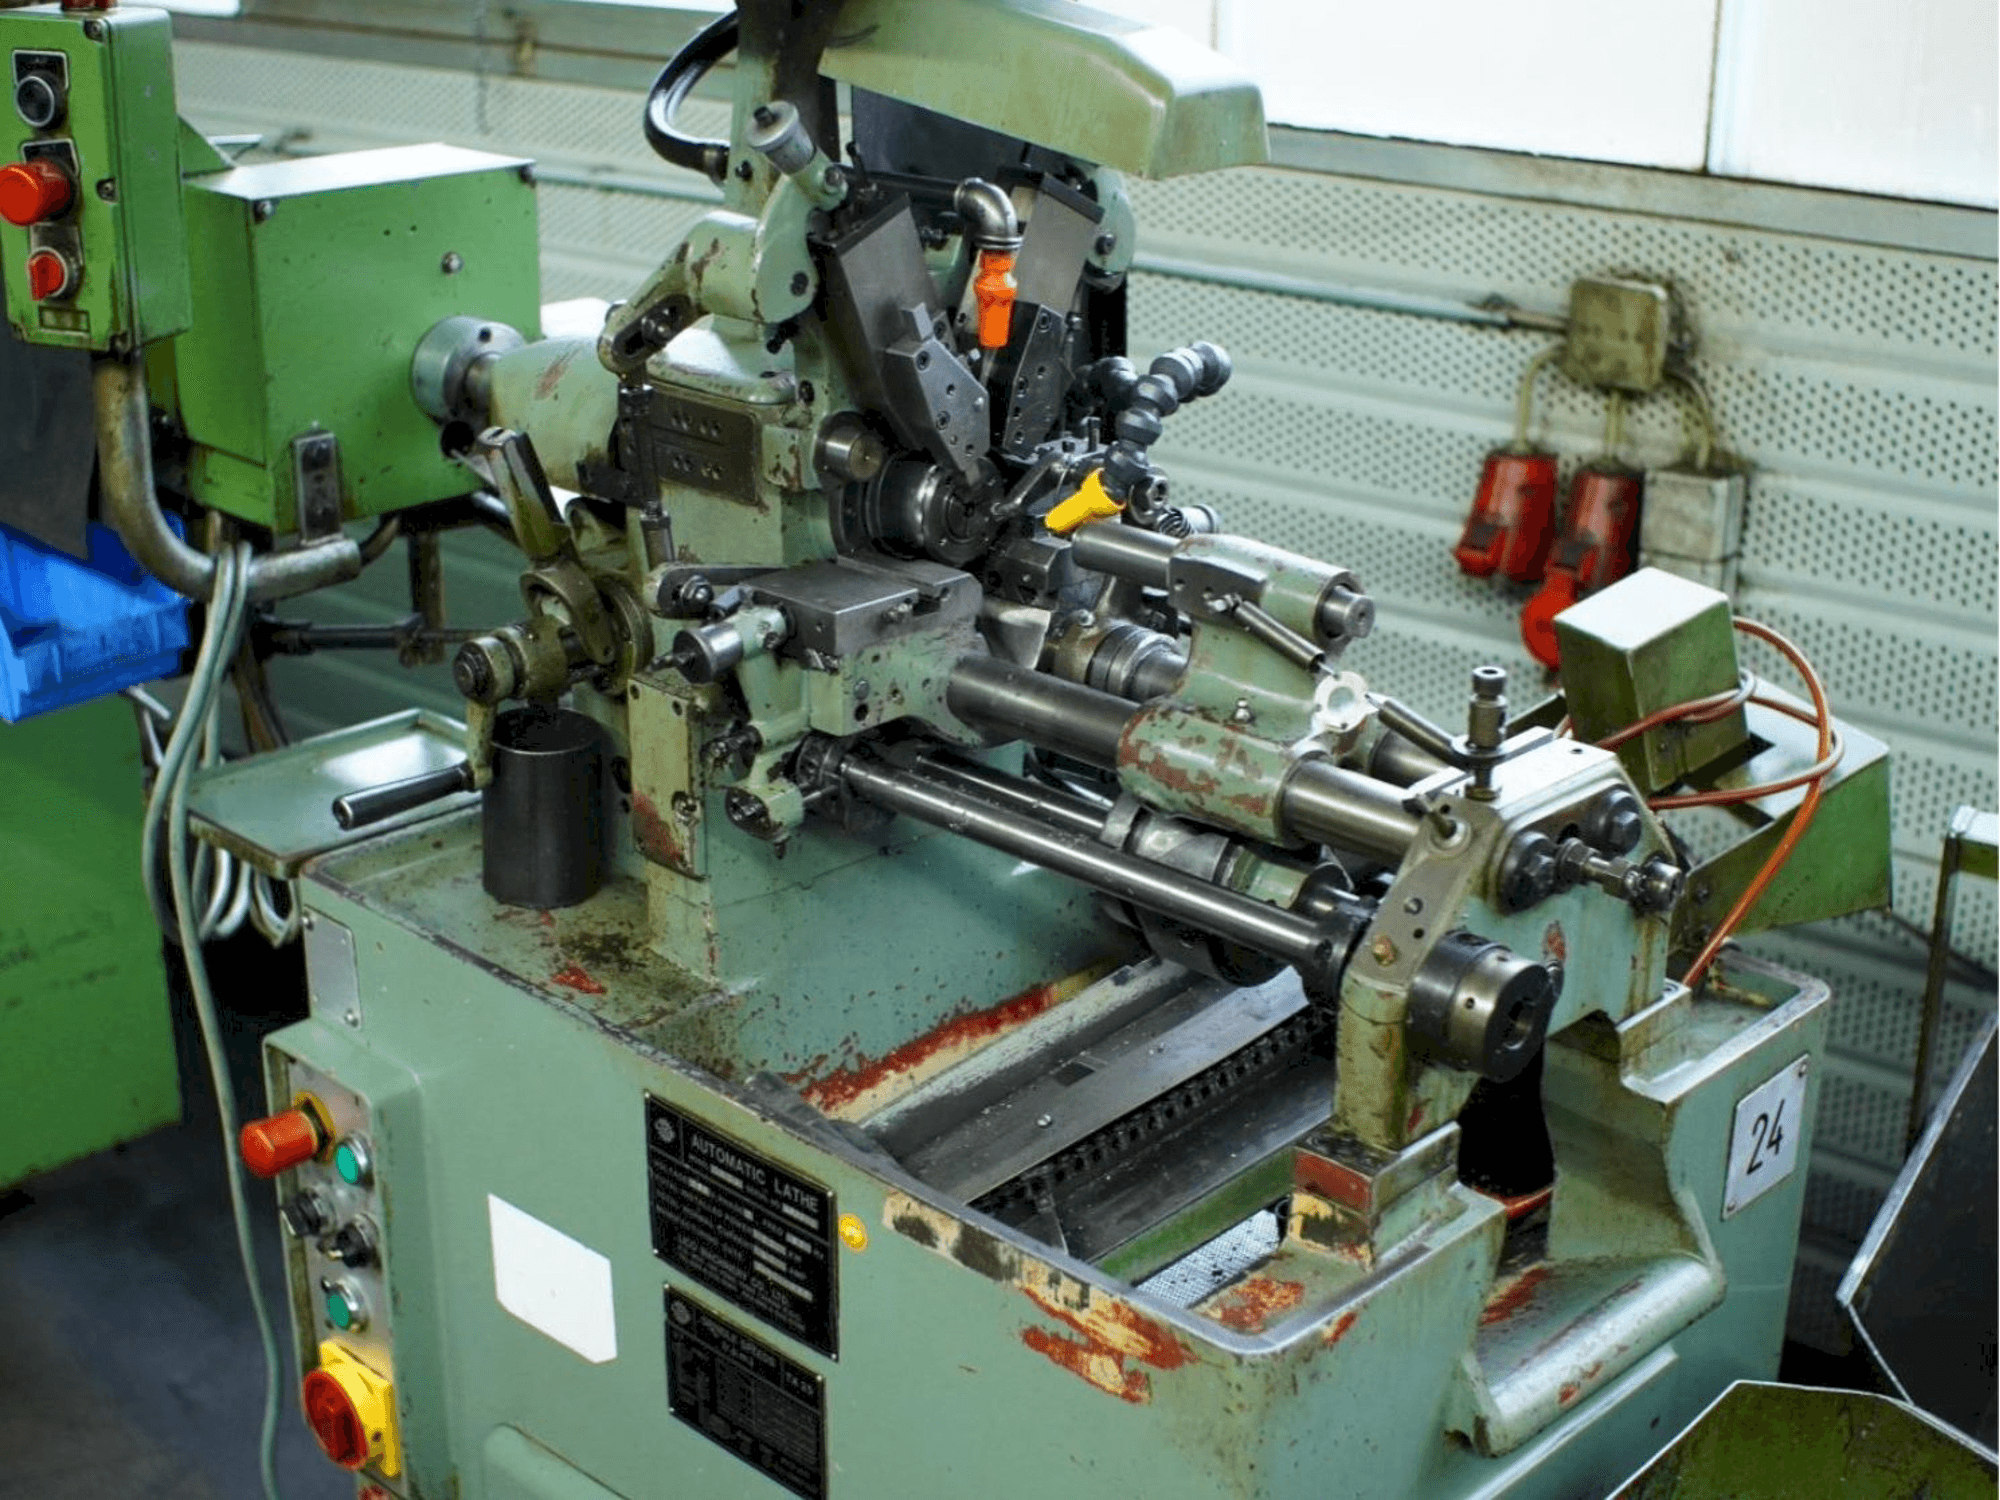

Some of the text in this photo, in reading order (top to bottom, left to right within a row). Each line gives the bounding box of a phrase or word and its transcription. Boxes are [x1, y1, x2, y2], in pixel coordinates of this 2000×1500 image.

[691, 1134, 767, 1185] AUTOMATIC
[773, 1177, 819, 1212] LATHE
[1746, 1099, 1785, 1175] 24
